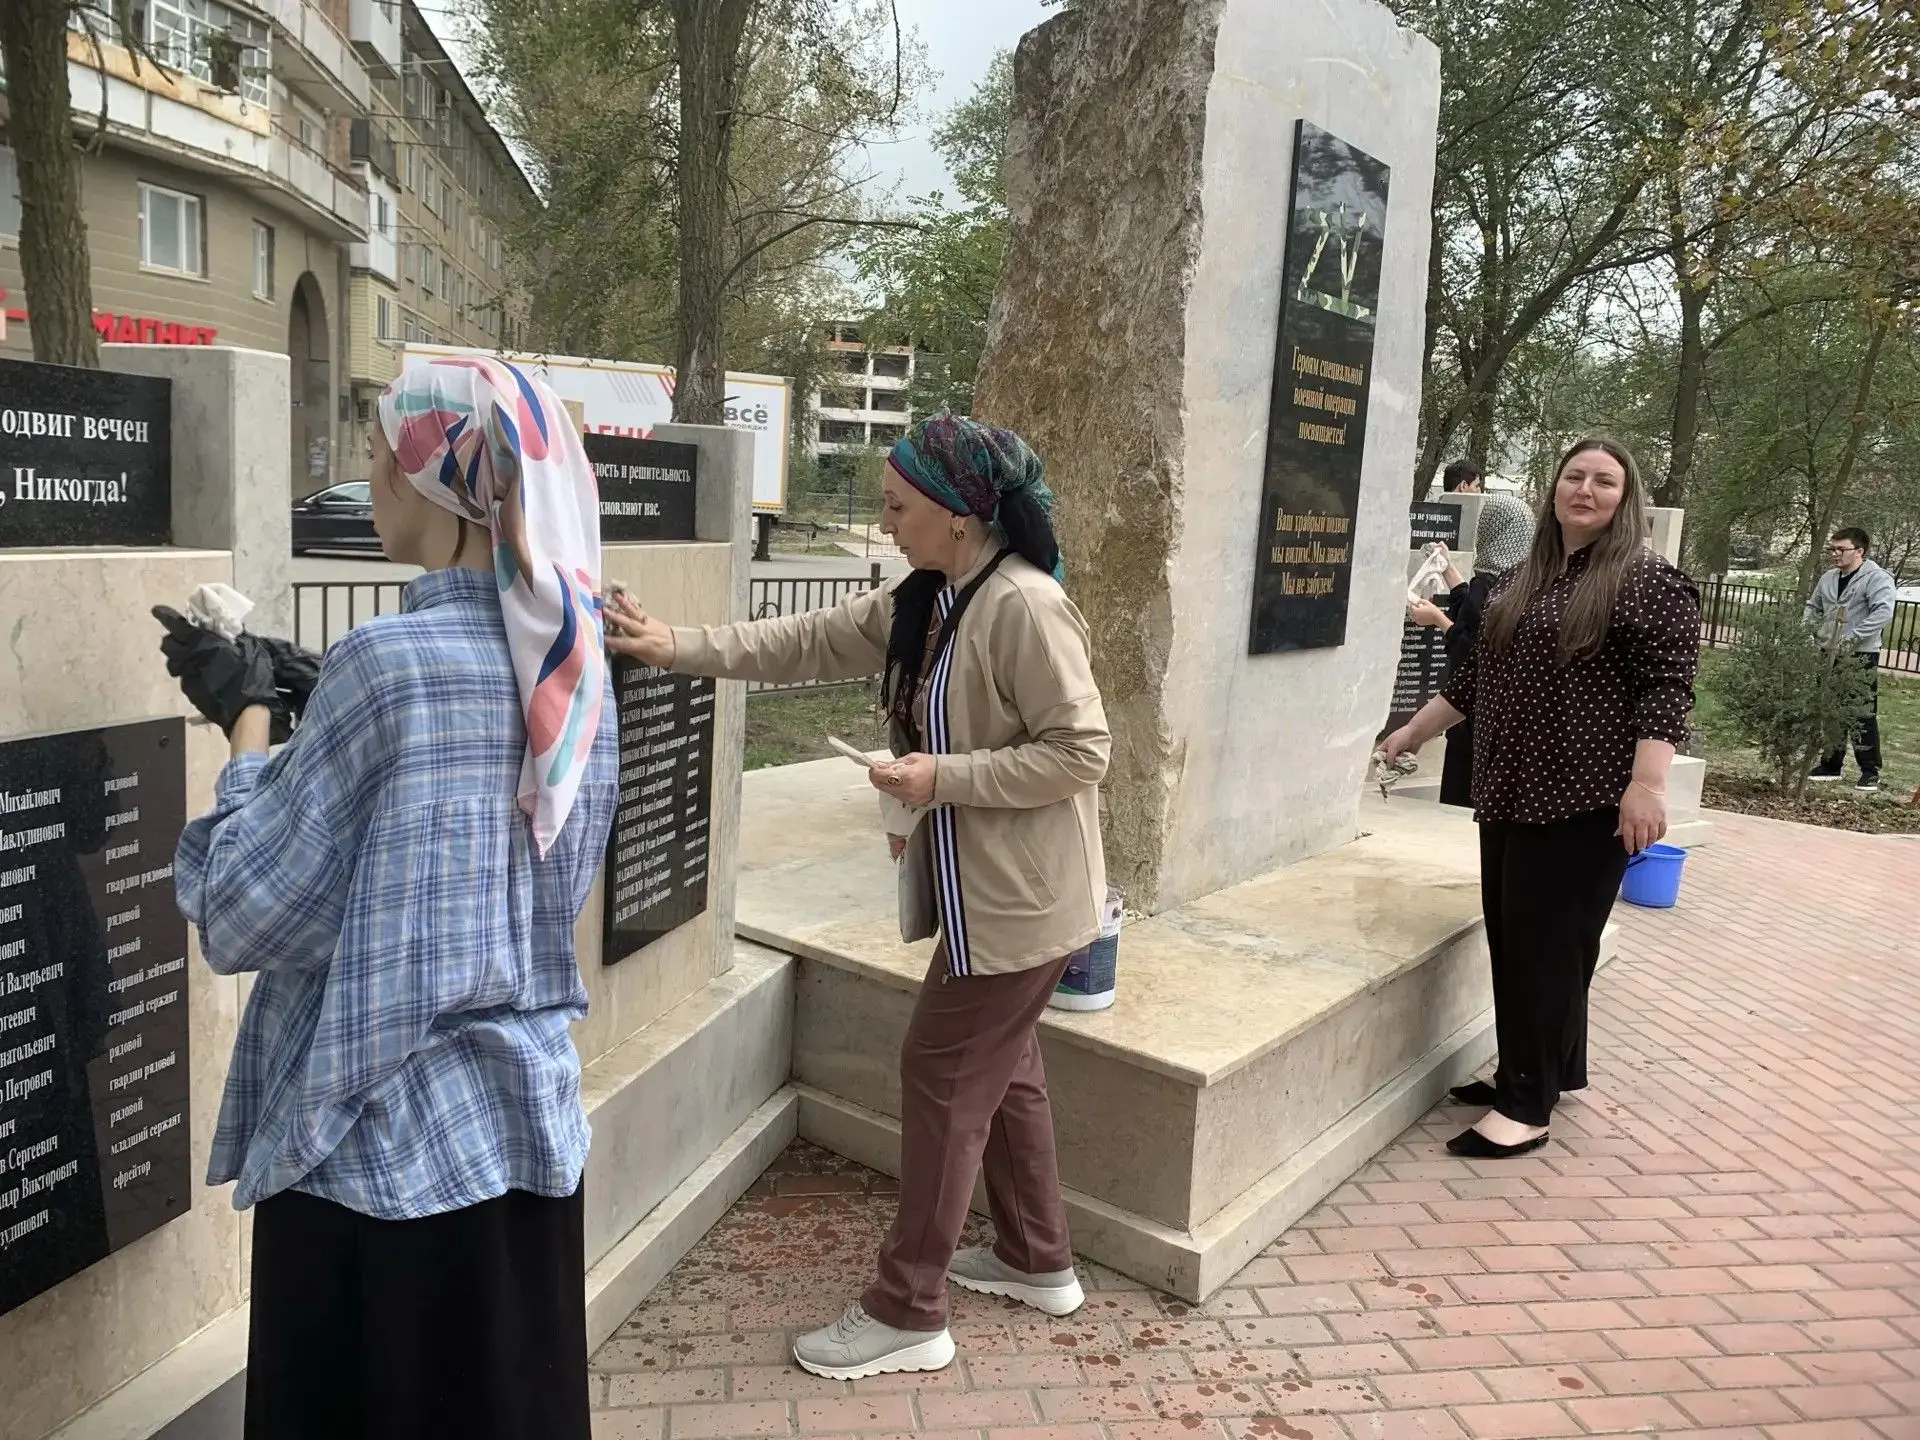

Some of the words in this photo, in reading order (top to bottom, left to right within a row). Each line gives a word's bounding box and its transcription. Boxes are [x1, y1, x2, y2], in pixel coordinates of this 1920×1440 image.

[91, 312, 218, 345] МАГНИТ
[1291, 346, 1320, 379] Героям
[1320, 363, 1364, 386] специальной
[1293, 386, 1324, 410] военной
[1324, 393, 1356, 419] операции
[0, 408, 76, 440] одвиг
[83, 416, 150, 443] вечен
[1298, 423, 1347, 445] посвящается!
[13, 467, 128, 506] Никогда!
[621, 464, 628, 478] и
[628, 465, 691, 484] решительность
[644, 502, 661, 516] нас.
[1276, 507, 1294, 531] Ваш
[1294, 509, 1326, 539] храбрый
[1326, 517, 1350, 534] подвиг
[1271, 546, 1285, 564] мы
[1311, 541, 1326, 563] Мы
[1281, 571, 1296, 595] Мы
[1296, 577, 1305, 594] не
[104, 772, 138, 796] рядовой
[105, 807, 139, 831] рядовой
[0, 822, 65, 852] авлудинович
[105, 839, 139, 864] рядовой
[106, 872, 140, 894] гвардии
[141, 863, 173, 888] рядовой
[107, 905, 140, 931] рядовой
[0, 939, 25, 961] ович
[107, 936, 141, 963] рядовой
[7, 962, 64, 993] Валерьевич
[108, 969, 144, 993] старший
[145, 957, 185, 981] лейтенант
[108, 1000, 145, 1026] старший
[146, 989, 178, 1013] сержант
[109, 1034, 142, 1062] рядовой
[5, 1069, 53, 1100] Петрович
[109, 1067, 143, 1092] гвардии
[144, 1051, 176, 1079] рядовой
[110, 1097, 143, 1128] рядовой
[110, 1127, 149, 1155] младший
[149, 1112, 181, 1139] сержант
[8, 1135, 58, 1171] Сергеевич
[0, 1187, 20, 1209] ндр
[21, 1160, 78, 1199] Викторович
[113, 1160, 151, 1189] ефрейтор
